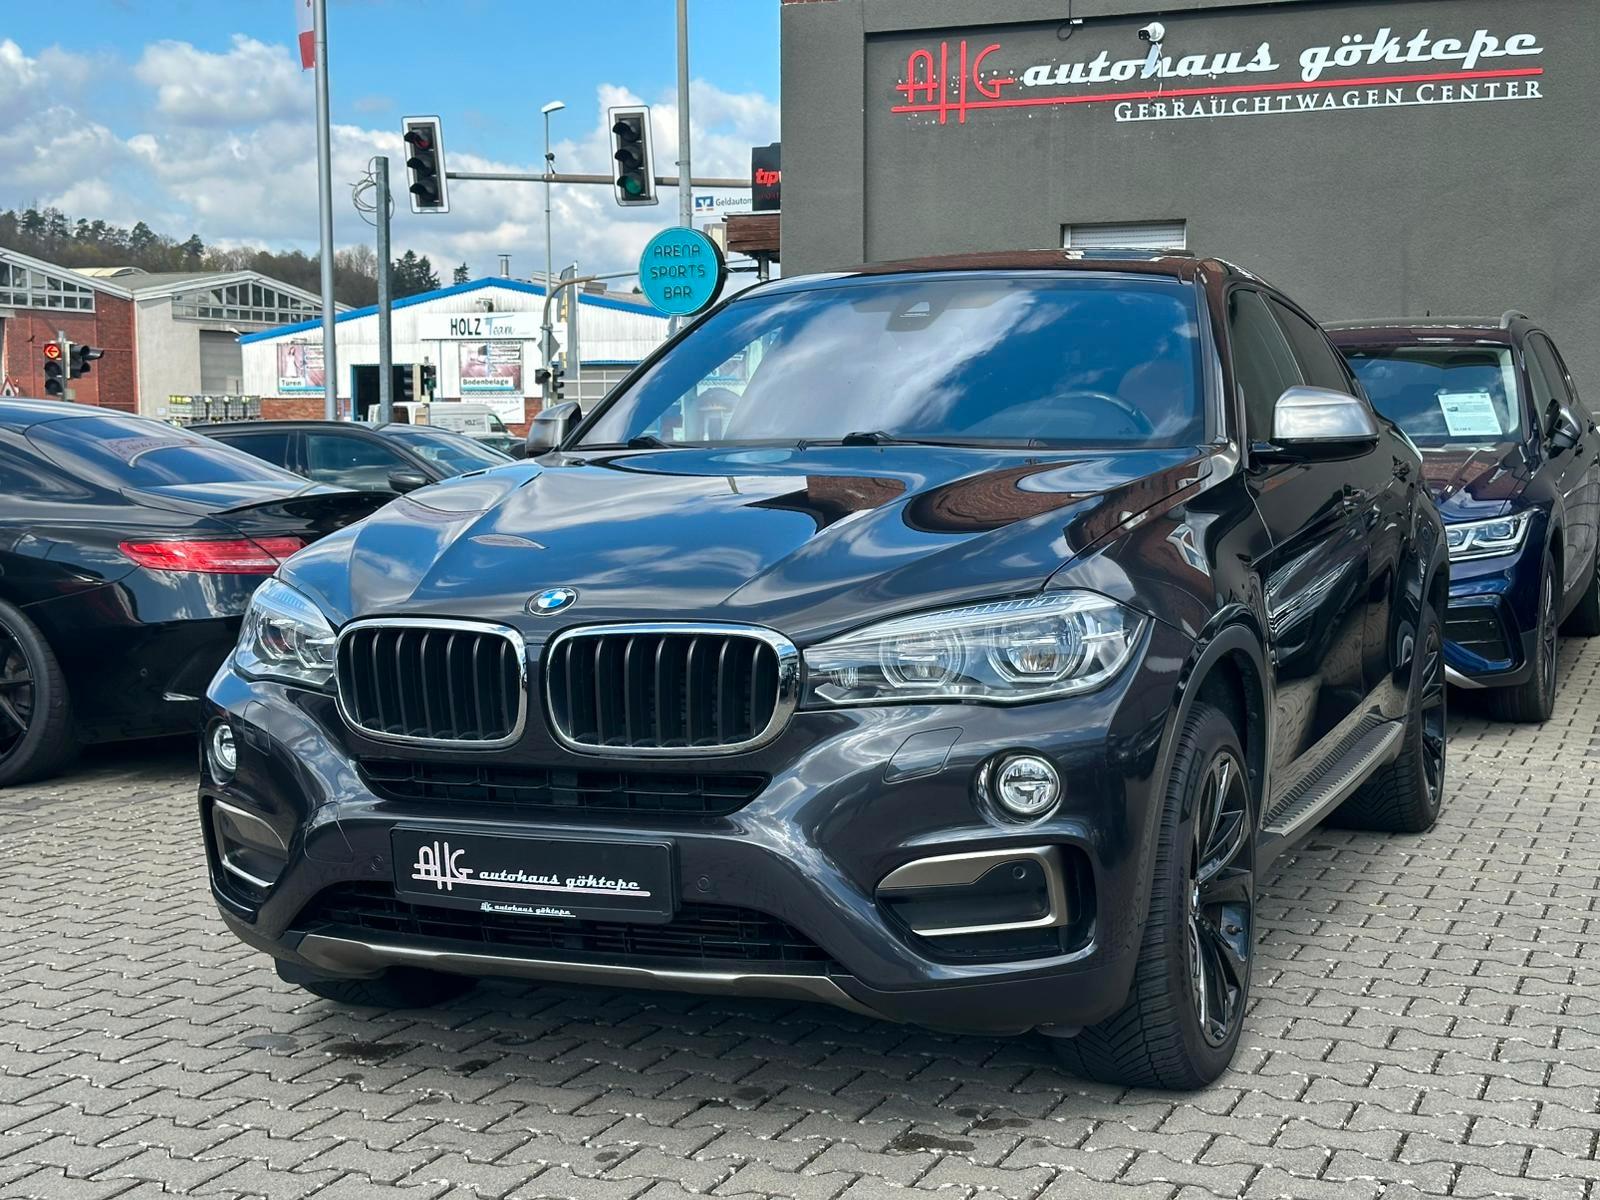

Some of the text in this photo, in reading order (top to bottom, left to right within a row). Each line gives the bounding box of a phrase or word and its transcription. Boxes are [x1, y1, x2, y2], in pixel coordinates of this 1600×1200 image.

[1022, 42, 1280, 88] autohaus
[1298, 28, 1545, 82] göktepe
[1114, 78, 1542, 123] GEBRAUCHTWAGEN CENTER
[755, 168, 782, 187] tip
[653, 244, 701, 257] ARENA
[650, 264, 706, 279] SPORTS
[663, 285, 693, 300] BAR
[450, 314, 515, 336] HOLZ Team
[479, 869, 561, 886] autohaus
[565, 875, 641, 892] göktepe
[494, 904, 534, 913] autohaus
